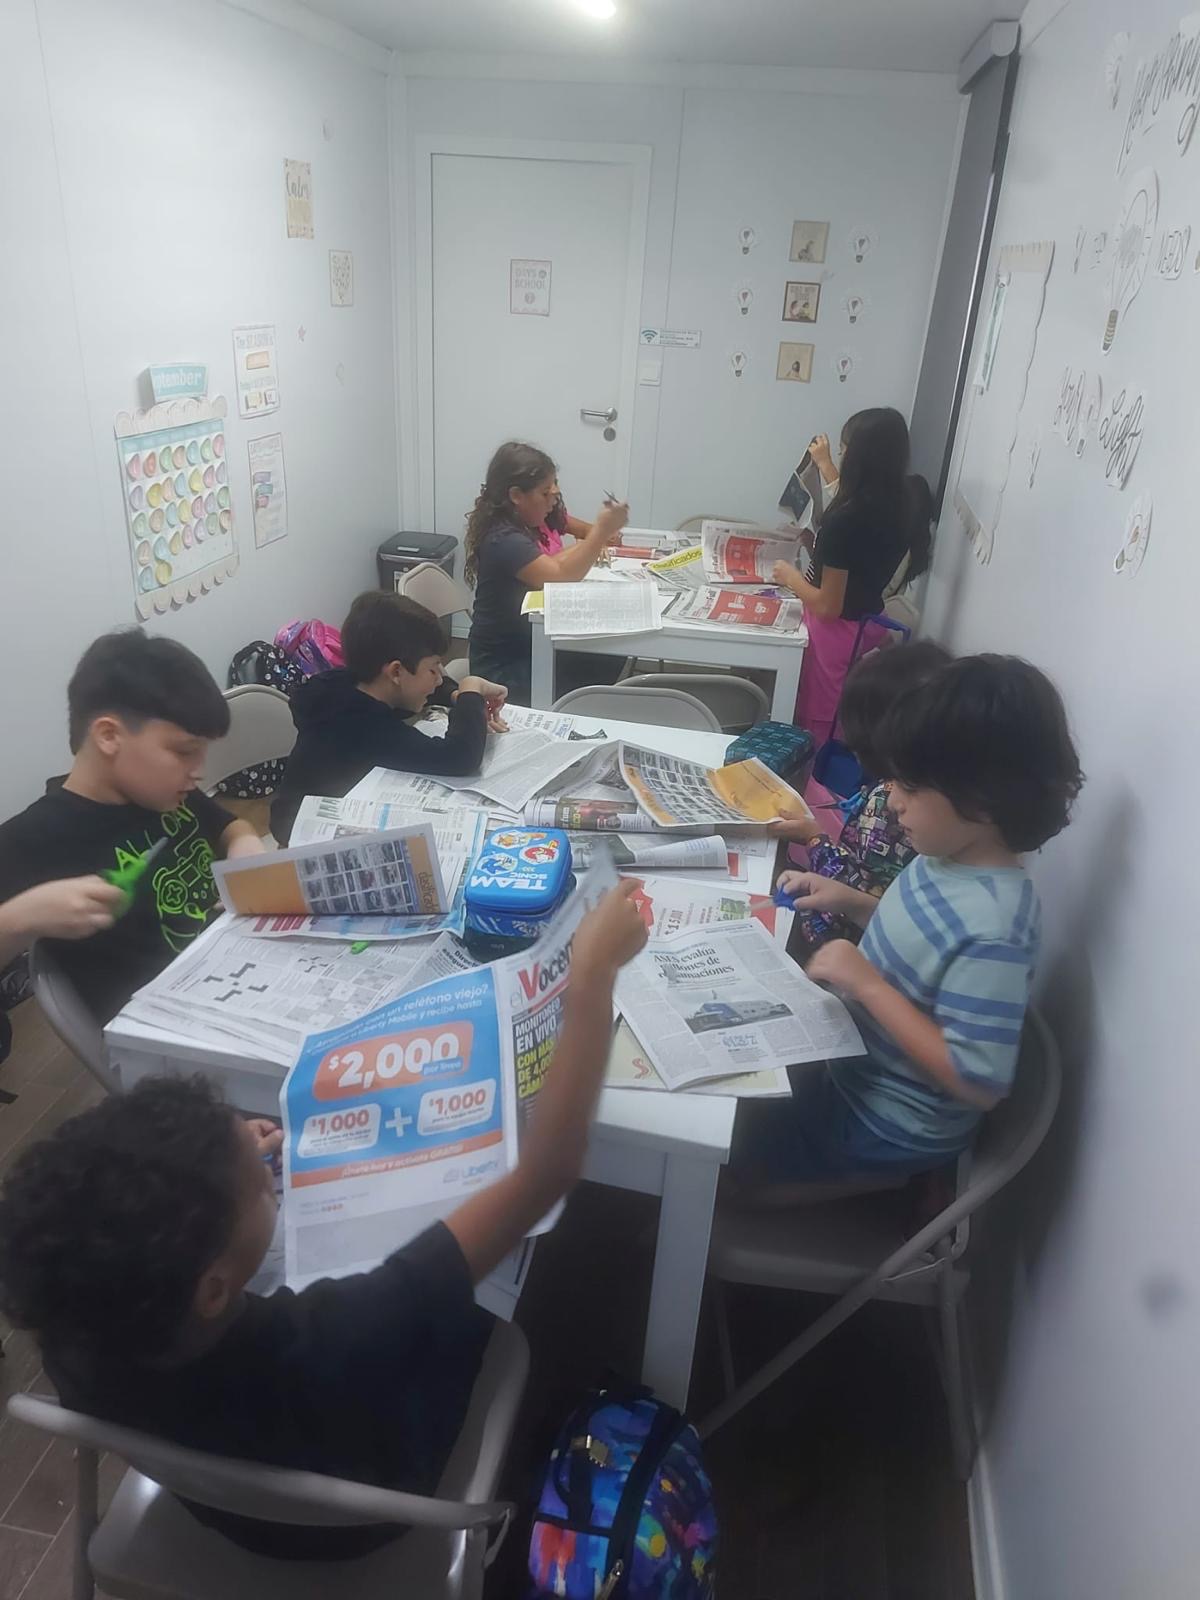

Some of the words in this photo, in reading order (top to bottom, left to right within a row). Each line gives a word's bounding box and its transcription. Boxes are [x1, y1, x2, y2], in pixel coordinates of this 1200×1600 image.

[153, 369, 202, 395] ptember
[470, 875, 547, 891] TEAM
[510, 871, 548, 880] SONIC
[706, 956, 721, 966] de
[517, 944, 573, 1001] Vocer
[455, 984, 489, 1001] viejo?
[427, 1004, 455, 1016] recibe
[516, 1031, 534, 1054] EN
[328, 1032, 460, 1089] $2,000
